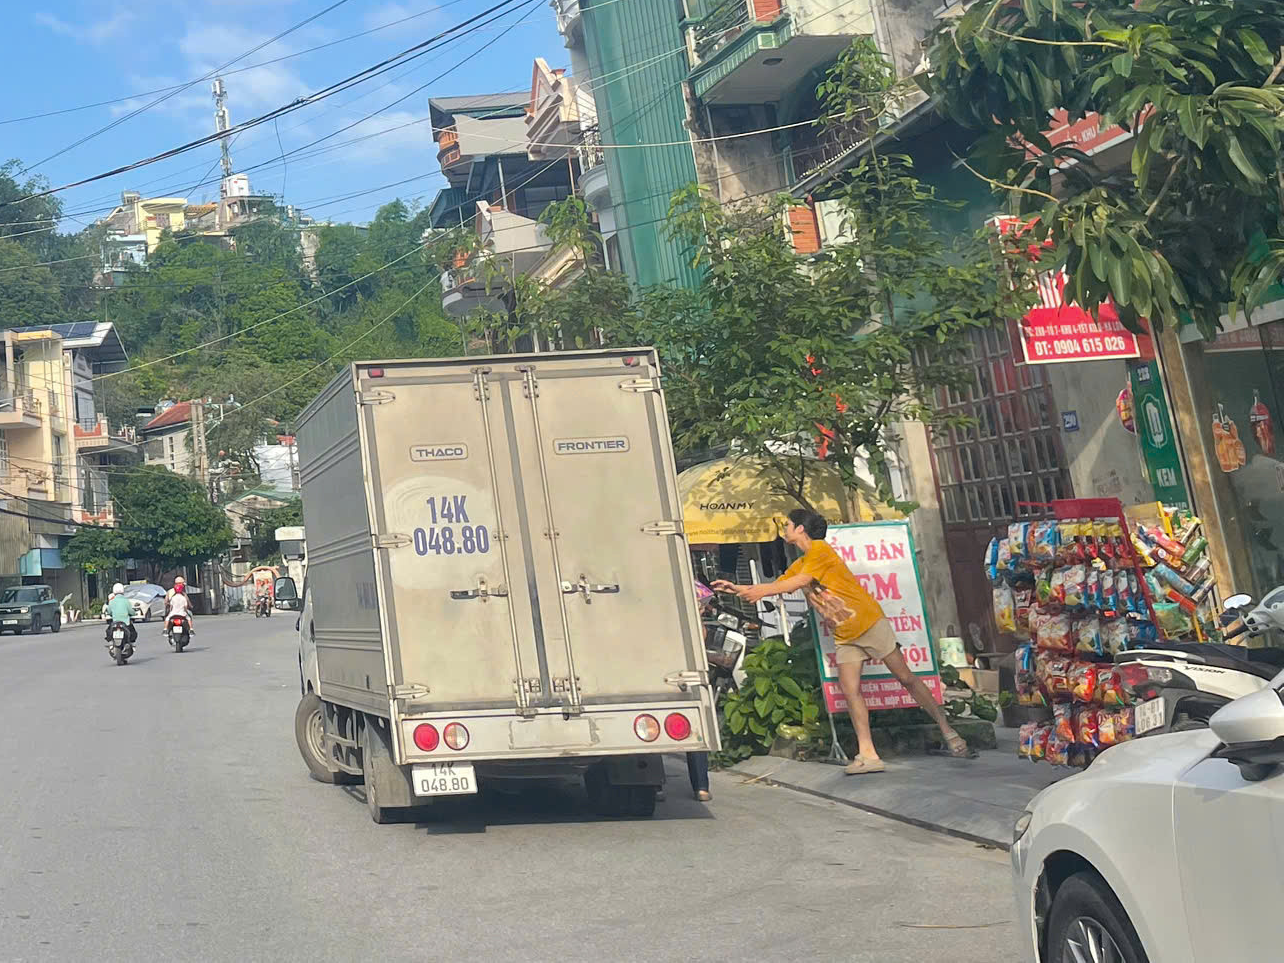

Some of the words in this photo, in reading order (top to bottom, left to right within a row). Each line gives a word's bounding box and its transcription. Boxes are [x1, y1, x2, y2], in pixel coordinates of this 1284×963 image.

[1053, 338, 1081, 355] 0904
[1082, 337, 1103, 353] 615
[1104, 335, 1125, 351] 026
[416, 447, 464, 458] THACO
[557, 440, 626, 451] FRONTIER
[426, 495, 470, 524] 14K
[413, 524, 490, 556] 048.80
[855, 573, 902, 601] EM
[1184, 665, 1225, 674] VISION
[432, 762, 456, 776] 14K
[421, 777, 469, 792] 048.80
